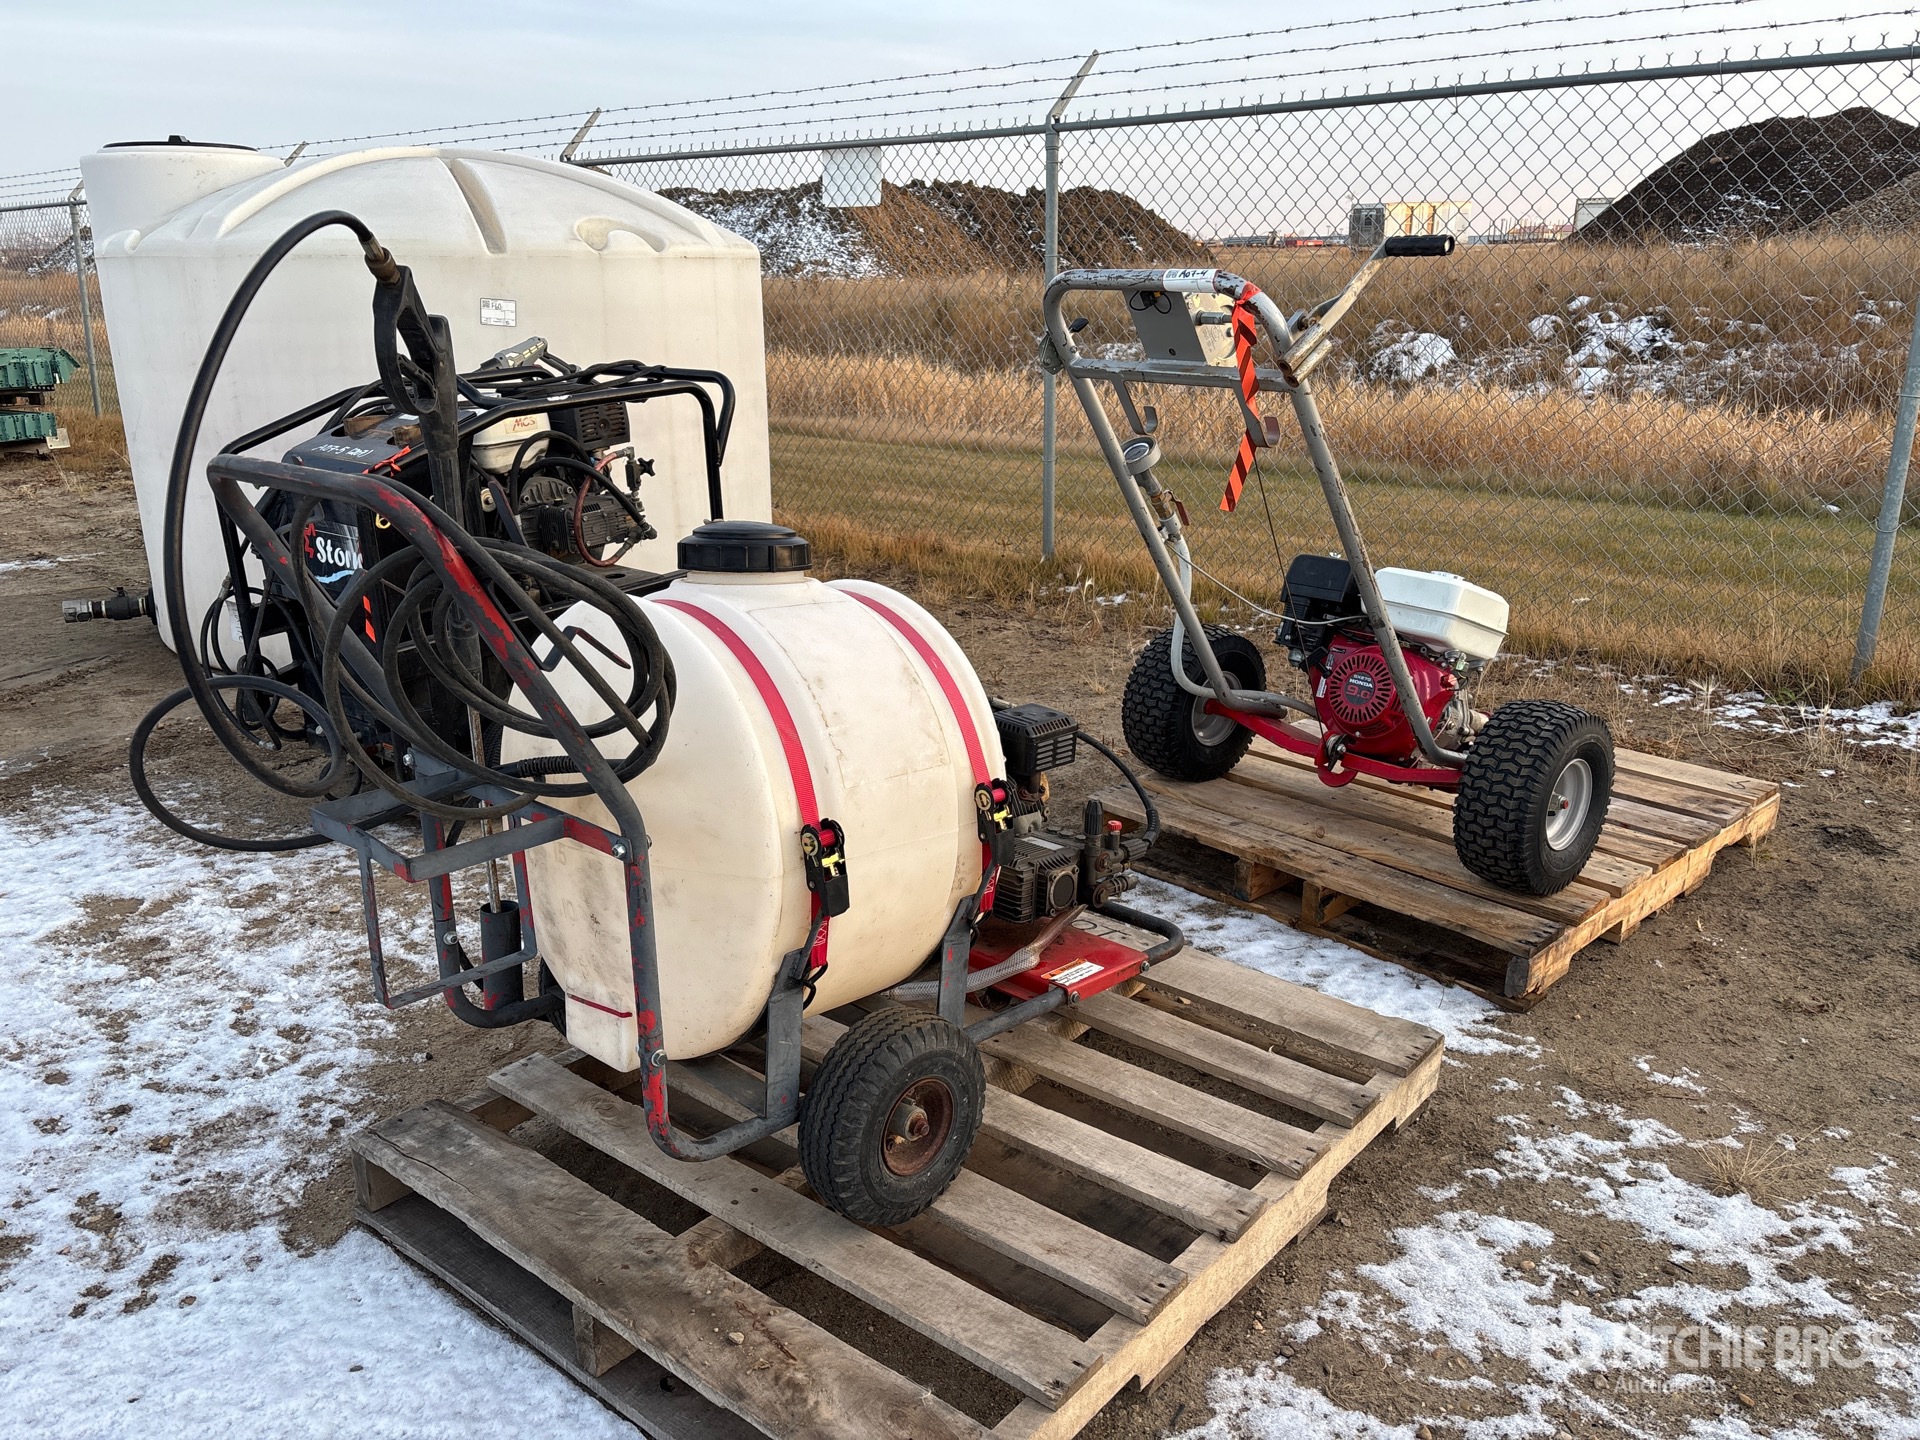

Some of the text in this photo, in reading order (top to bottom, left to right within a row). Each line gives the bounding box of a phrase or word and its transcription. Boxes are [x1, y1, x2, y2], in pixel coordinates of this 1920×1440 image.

[1178, 269, 1209, 279] A07-4
[513, 416, 536, 432] MCS
[1349, 678, 1374, 688] HONDA
[1346, 684, 1371, 699] 9.0
